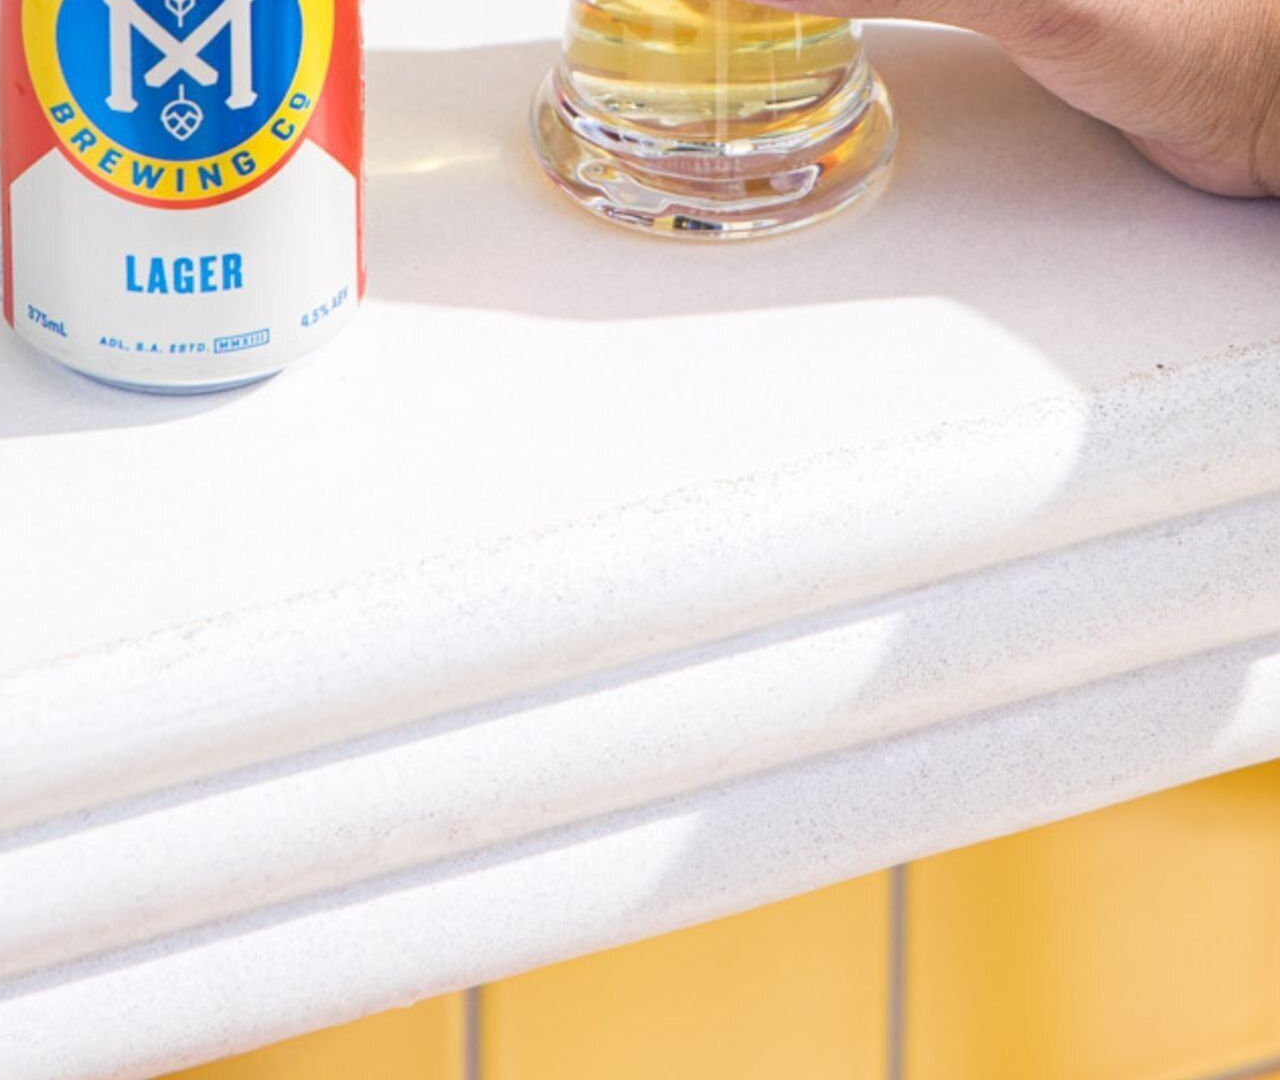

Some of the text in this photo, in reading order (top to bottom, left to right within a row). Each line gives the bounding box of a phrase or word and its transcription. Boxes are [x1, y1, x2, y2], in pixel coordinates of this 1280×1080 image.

[50, 101, 256, 192] BREWING
[125, 252, 243, 294] LAGER
[27, 304, 68, 338] 375mL
